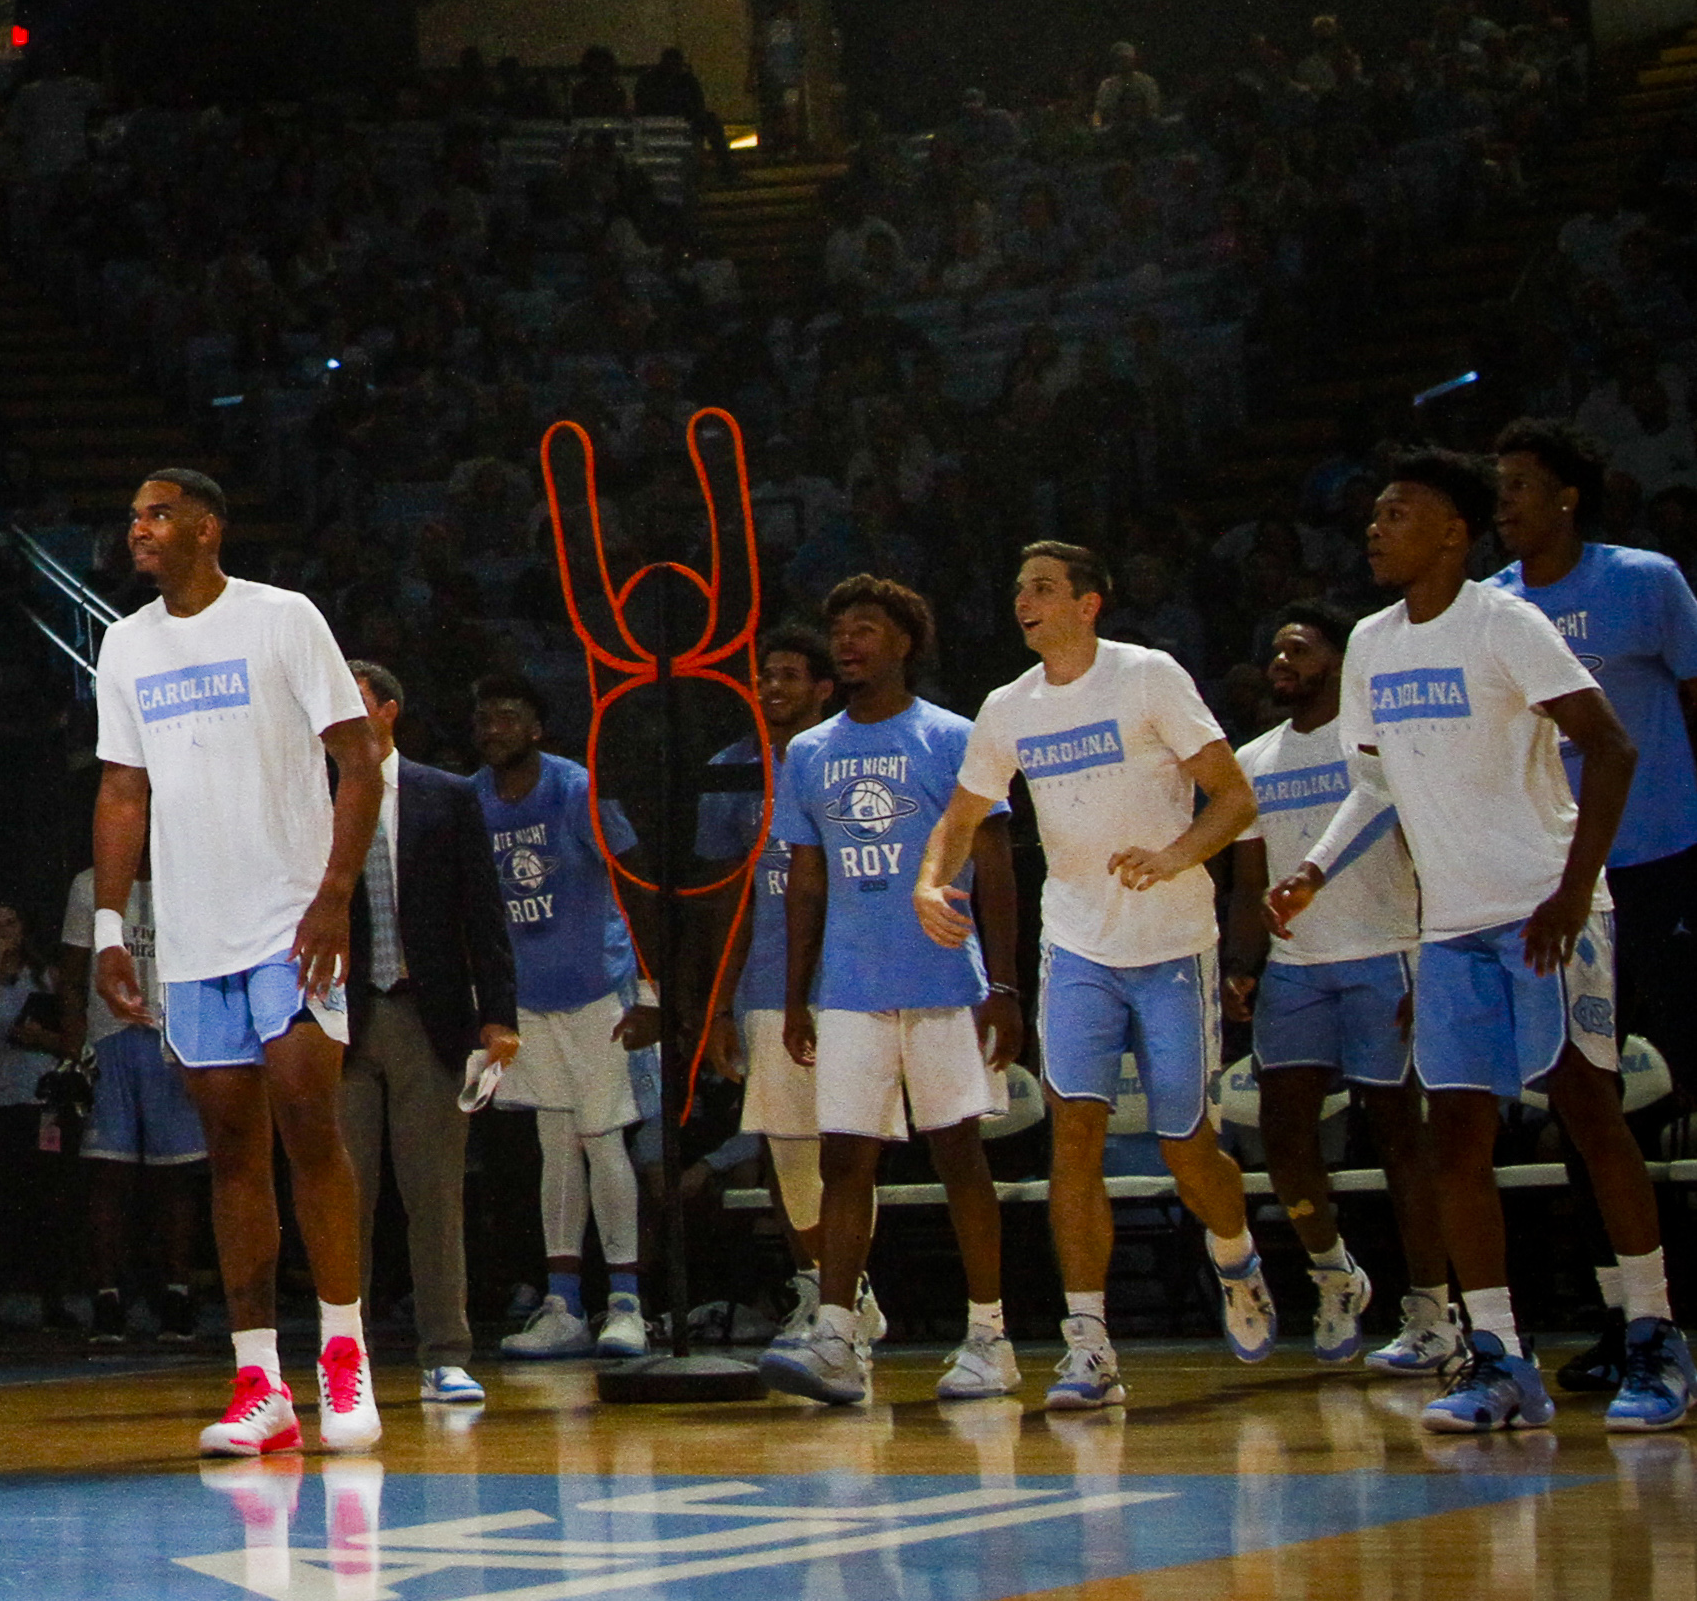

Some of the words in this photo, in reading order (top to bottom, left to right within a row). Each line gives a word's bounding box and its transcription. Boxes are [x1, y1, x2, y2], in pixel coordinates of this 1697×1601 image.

[1556, 610, 1588, 639] GHT
[139, 672, 246, 711] CAROLINA
[1019, 731, 1120, 769] CAROLINA
[824, 759, 858, 789] LATE
[863, 756, 908, 783] NIGHT
[1255, 772, 1346, 804] CAROLINA
[515, 823, 548, 846] NIGHT
[840, 843, 903, 877] ROY
[507, 894, 554, 924] ROY
